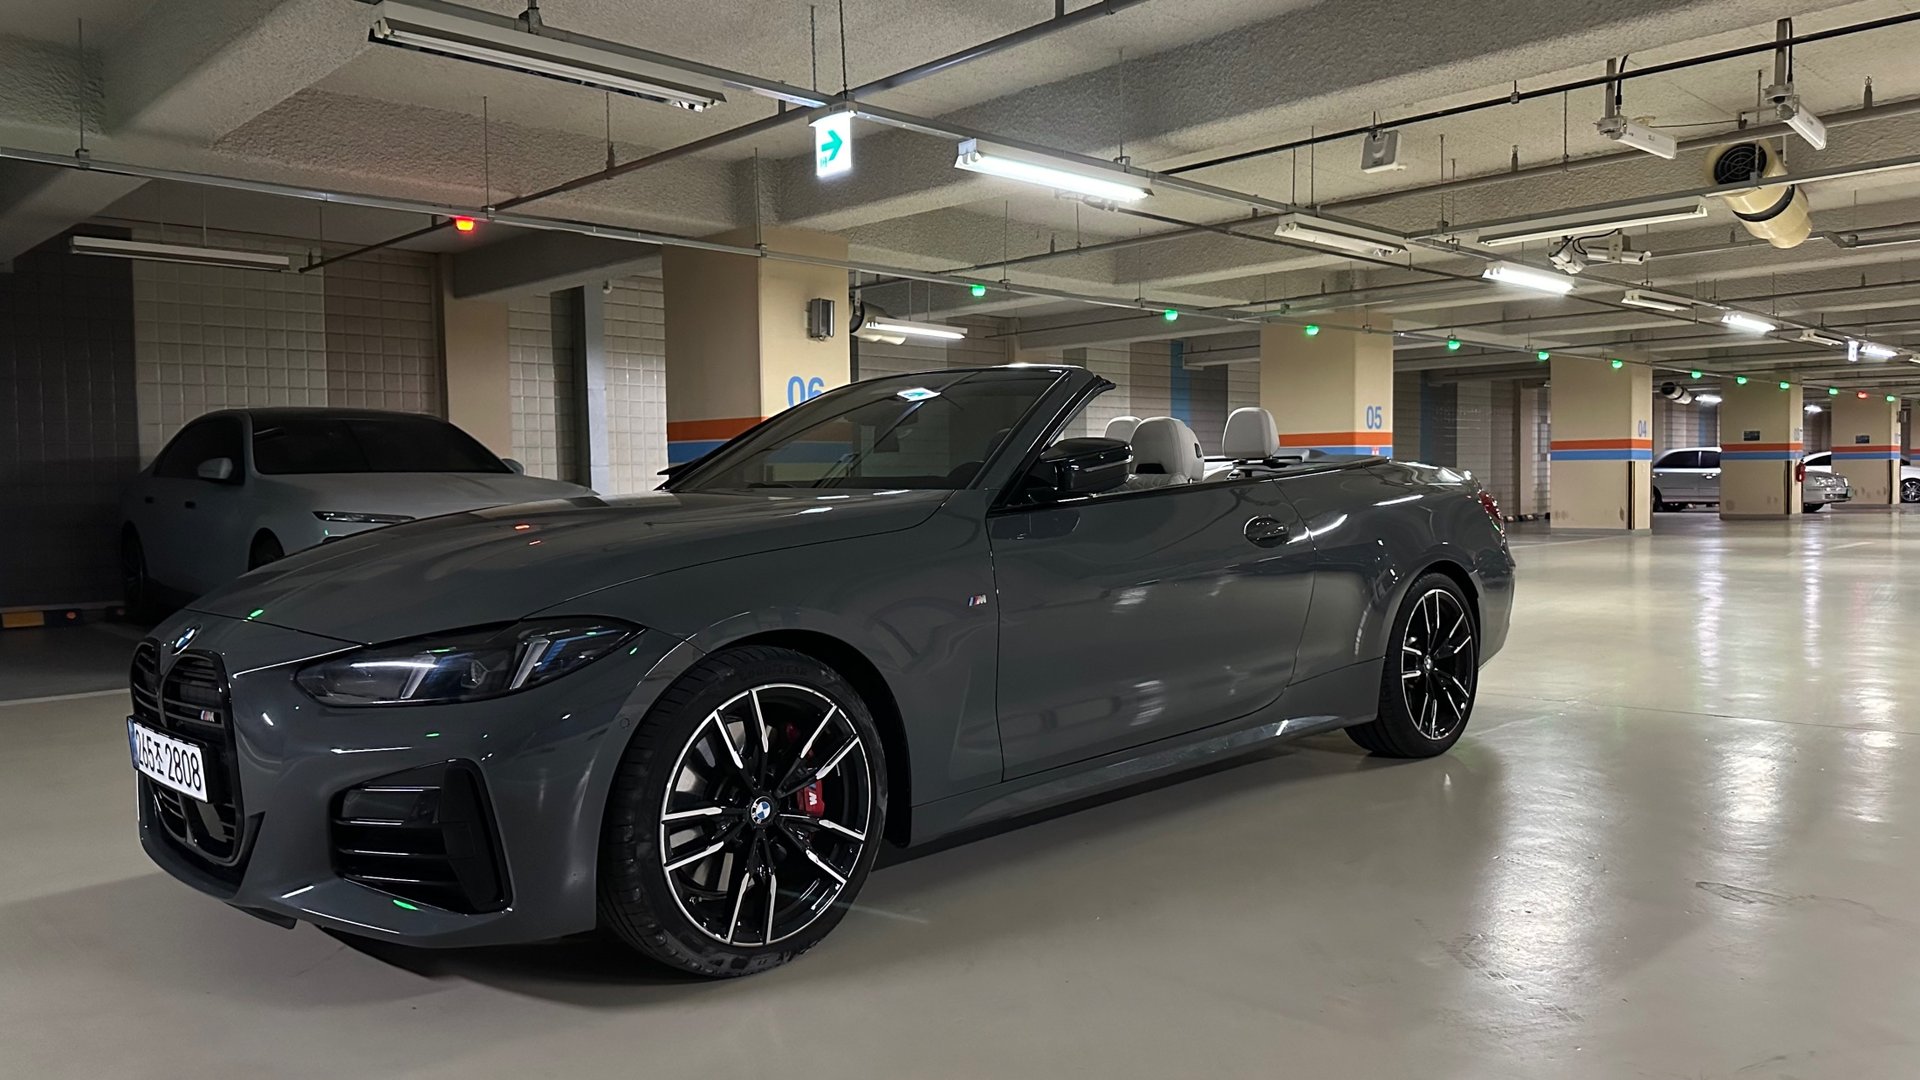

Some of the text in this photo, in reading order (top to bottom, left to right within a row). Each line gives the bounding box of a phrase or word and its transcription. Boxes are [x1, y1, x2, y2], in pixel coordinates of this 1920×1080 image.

[1366, 405, 1382, 429] 05
[1637, 419, 1647, 438] 04
[165, 743, 202, 791] 2808
